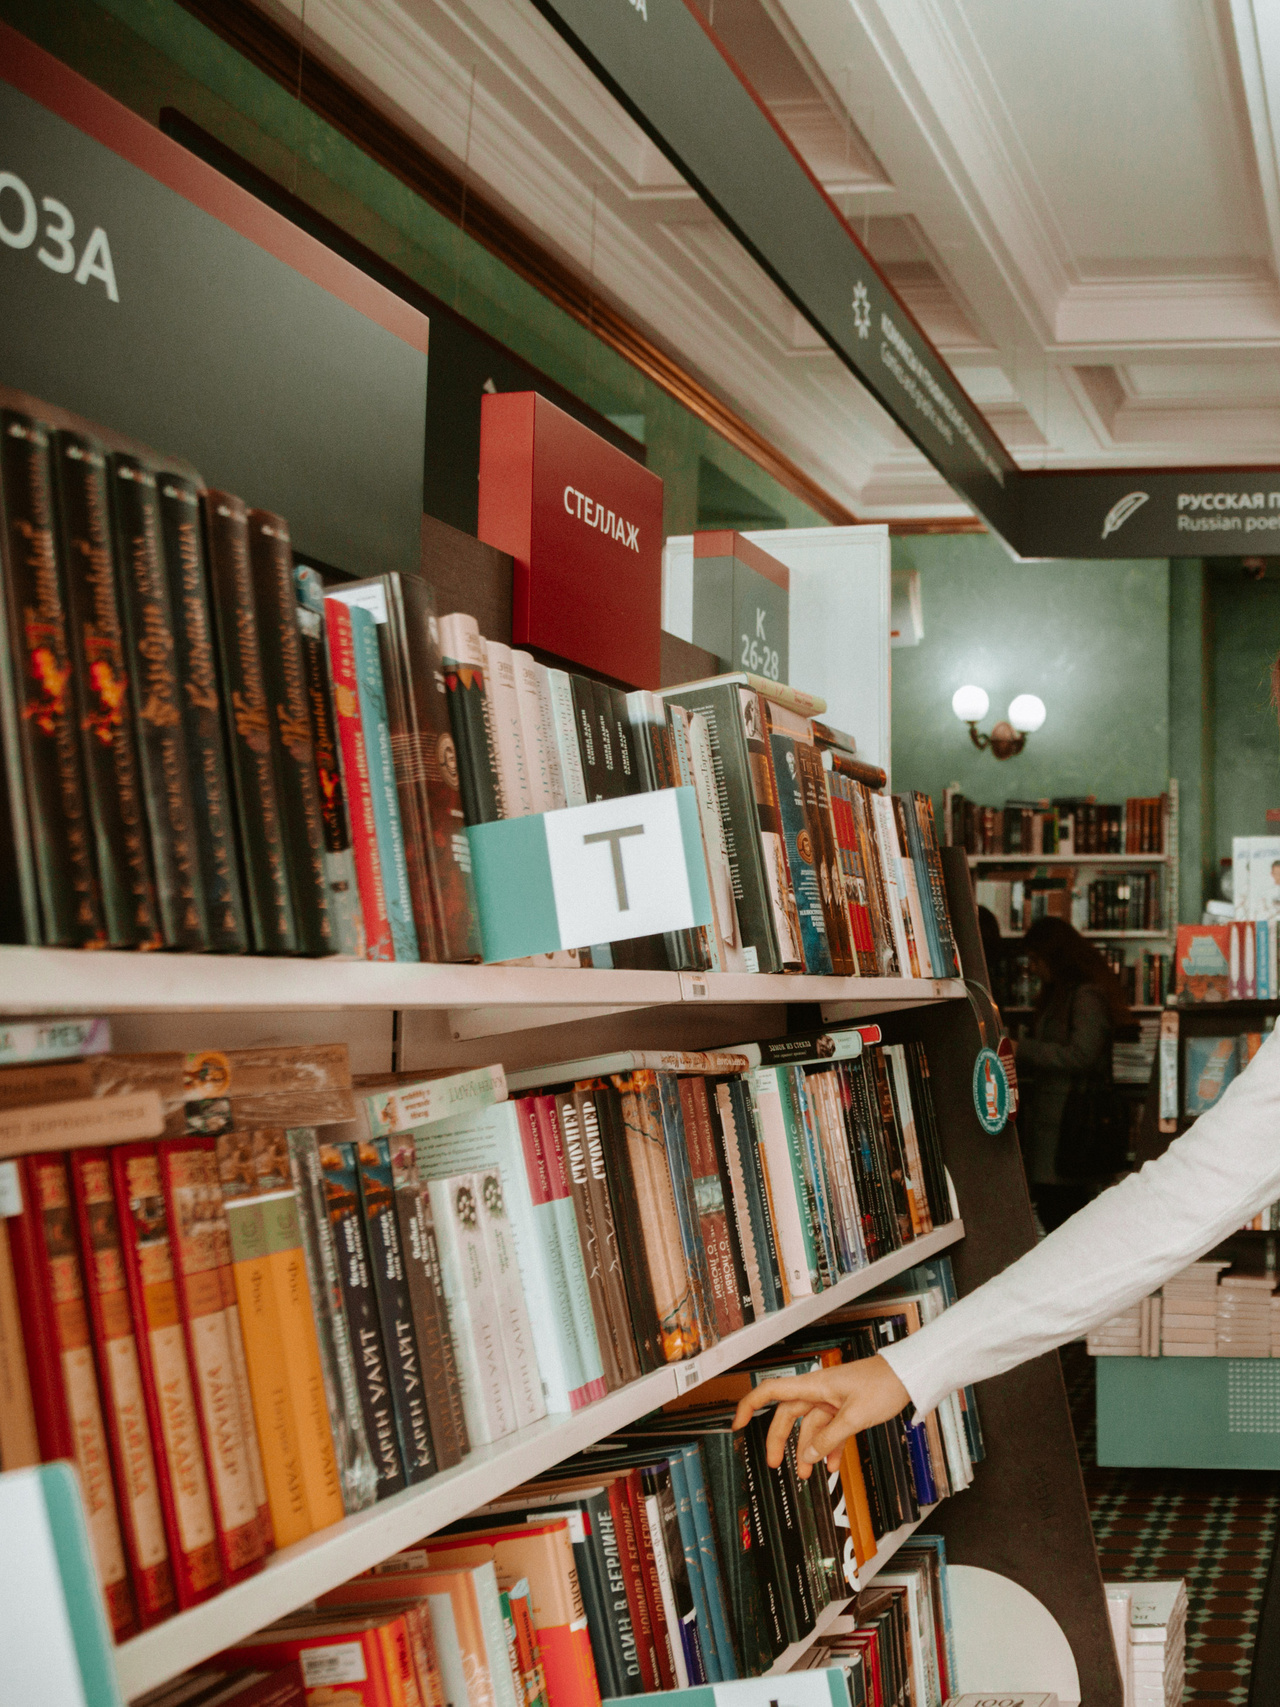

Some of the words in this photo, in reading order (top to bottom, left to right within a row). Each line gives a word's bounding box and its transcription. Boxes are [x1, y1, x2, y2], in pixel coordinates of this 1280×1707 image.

[564, 485, 640, 553] СТЕЛЛАЖ
[1177, 492, 1265, 511] РУССКАЯ
[1177, 514, 1243, 532] Russian
[741, 634, 779, 681] 26-28
[559, 1102, 588, 1184] СТОУНЕР
[579, 1100, 607, 1180] СТОУНЕР
[706, 1244, 715, 1255] О
[717, 1240, 726, 1251] О
[709, 1257, 723, 1299] ЛЮБВИ
[720, 1254, 734, 1294] ЛЮБВИ
[393, 1317, 420, 1393] УАЙТ
[480, 1322, 498, 1376] УАЙТ
[507, 1306, 525, 1358] УАЙТ
[358, 1326, 387, 1403] УАЙТ
[519, 1364, 536, 1413] КАРЕН
[406, 1398, 432, 1466] КАРЕН
[490, 1381, 507, 1432] КАРЕН
[373, 1408, 399, 1478] КАРЕН
[596, 1509, 625, 1592] БЕРЛИНЕ
[619, 1500, 638, 1559] БЕРЛИНЕ
[631, 1562, 640, 1572] В
[613, 1598, 628, 1611] В
[632, 1577, 652, 1634] КОШМАР
[616, 1617, 640, 1676] ОДИН
